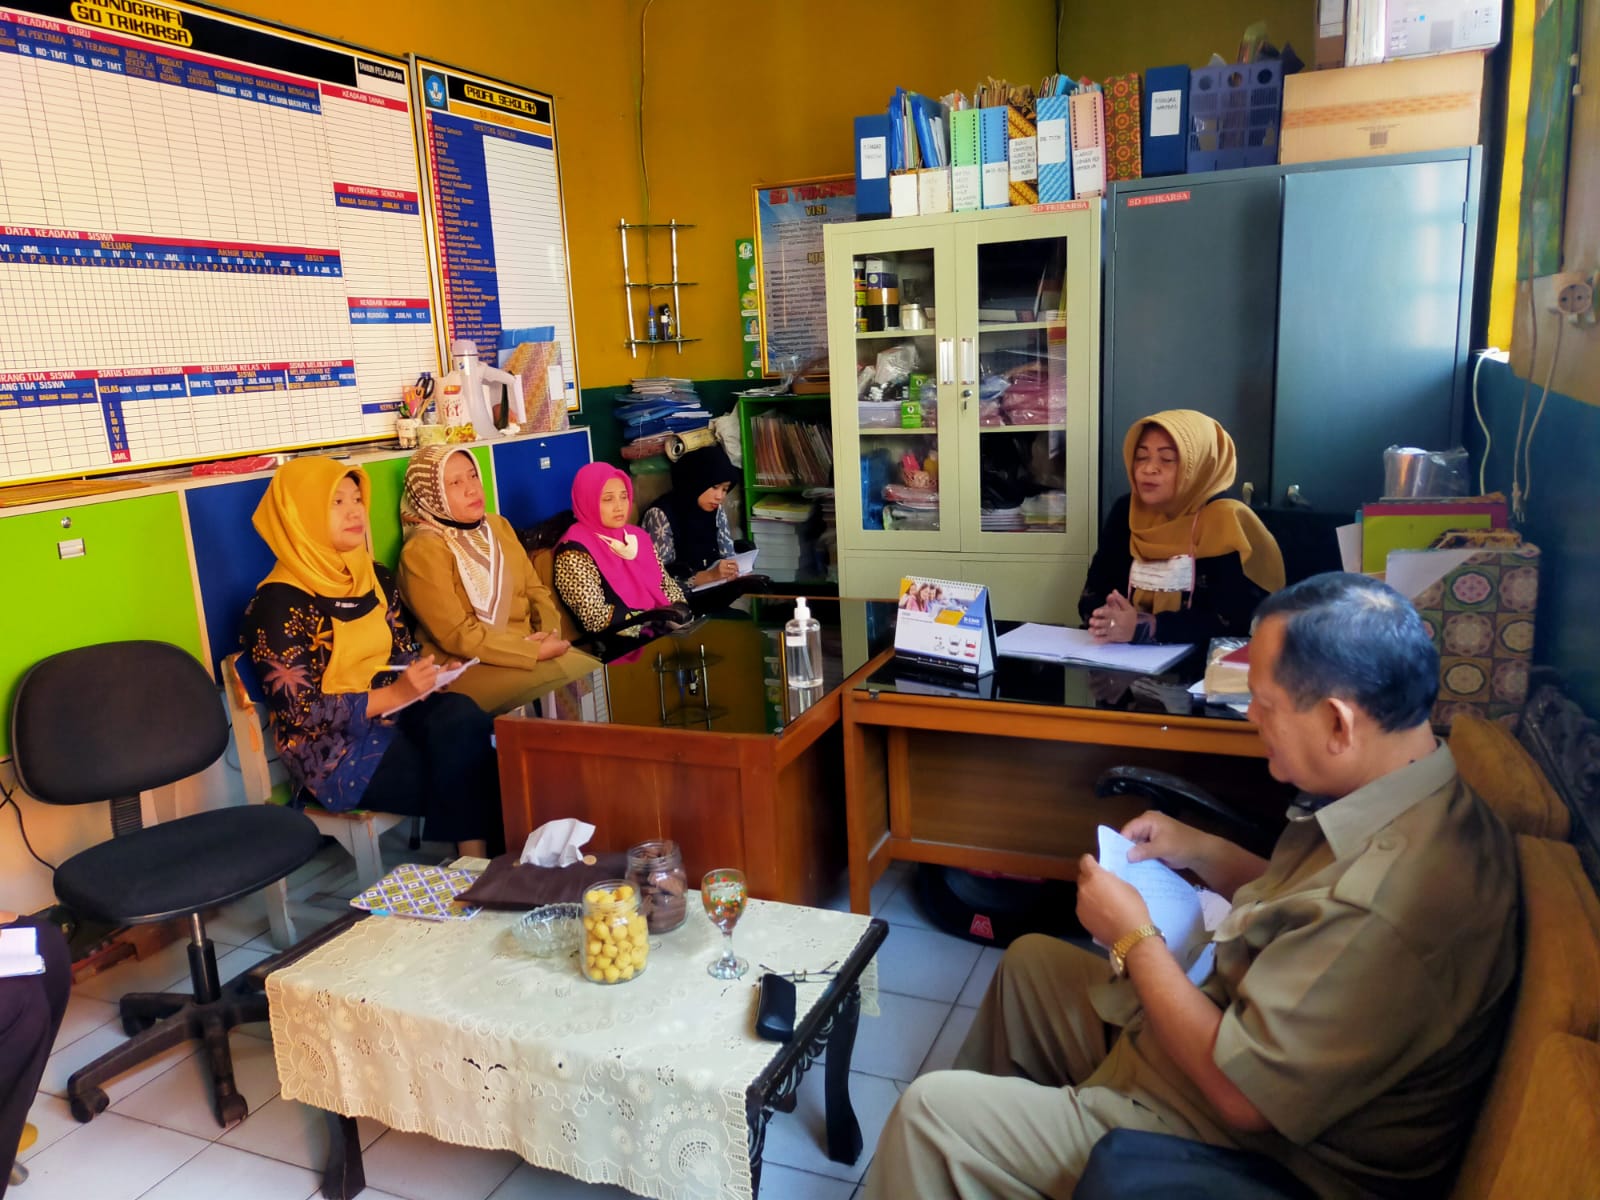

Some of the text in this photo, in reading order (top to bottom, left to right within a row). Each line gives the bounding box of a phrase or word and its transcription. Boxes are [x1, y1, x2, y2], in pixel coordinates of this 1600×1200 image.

[17, 15, 60, 32] KEADAAN
[66, 25, 91, 39] GURU
[77, 5, 189, 44] SD TRIKARSA
[466, 86, 536, 113] PROFIL SEKOLAH
[1129, 192, 1188, 206] SD TRIKARSA
[805, 205, 828, 217] VISI
[1044, 202, 1088, 212] TRIKARSA
[5, 226, 115, 242] DATA KEADAAN SISWA
[101, 241, 133, 251] KELUAR
[807, 252, 825, 265] MIS
[240, 363, 260, 371] KELAS
[262, 363, 271, 371] VI
[28, 372, 46, 382] TUA
[49, 371, 77, 381] SISWA
[98, 369, 123, 378] STATUS
[19, 381, 37, 391] TUA
[39, 380, 66, 390] SISWA
